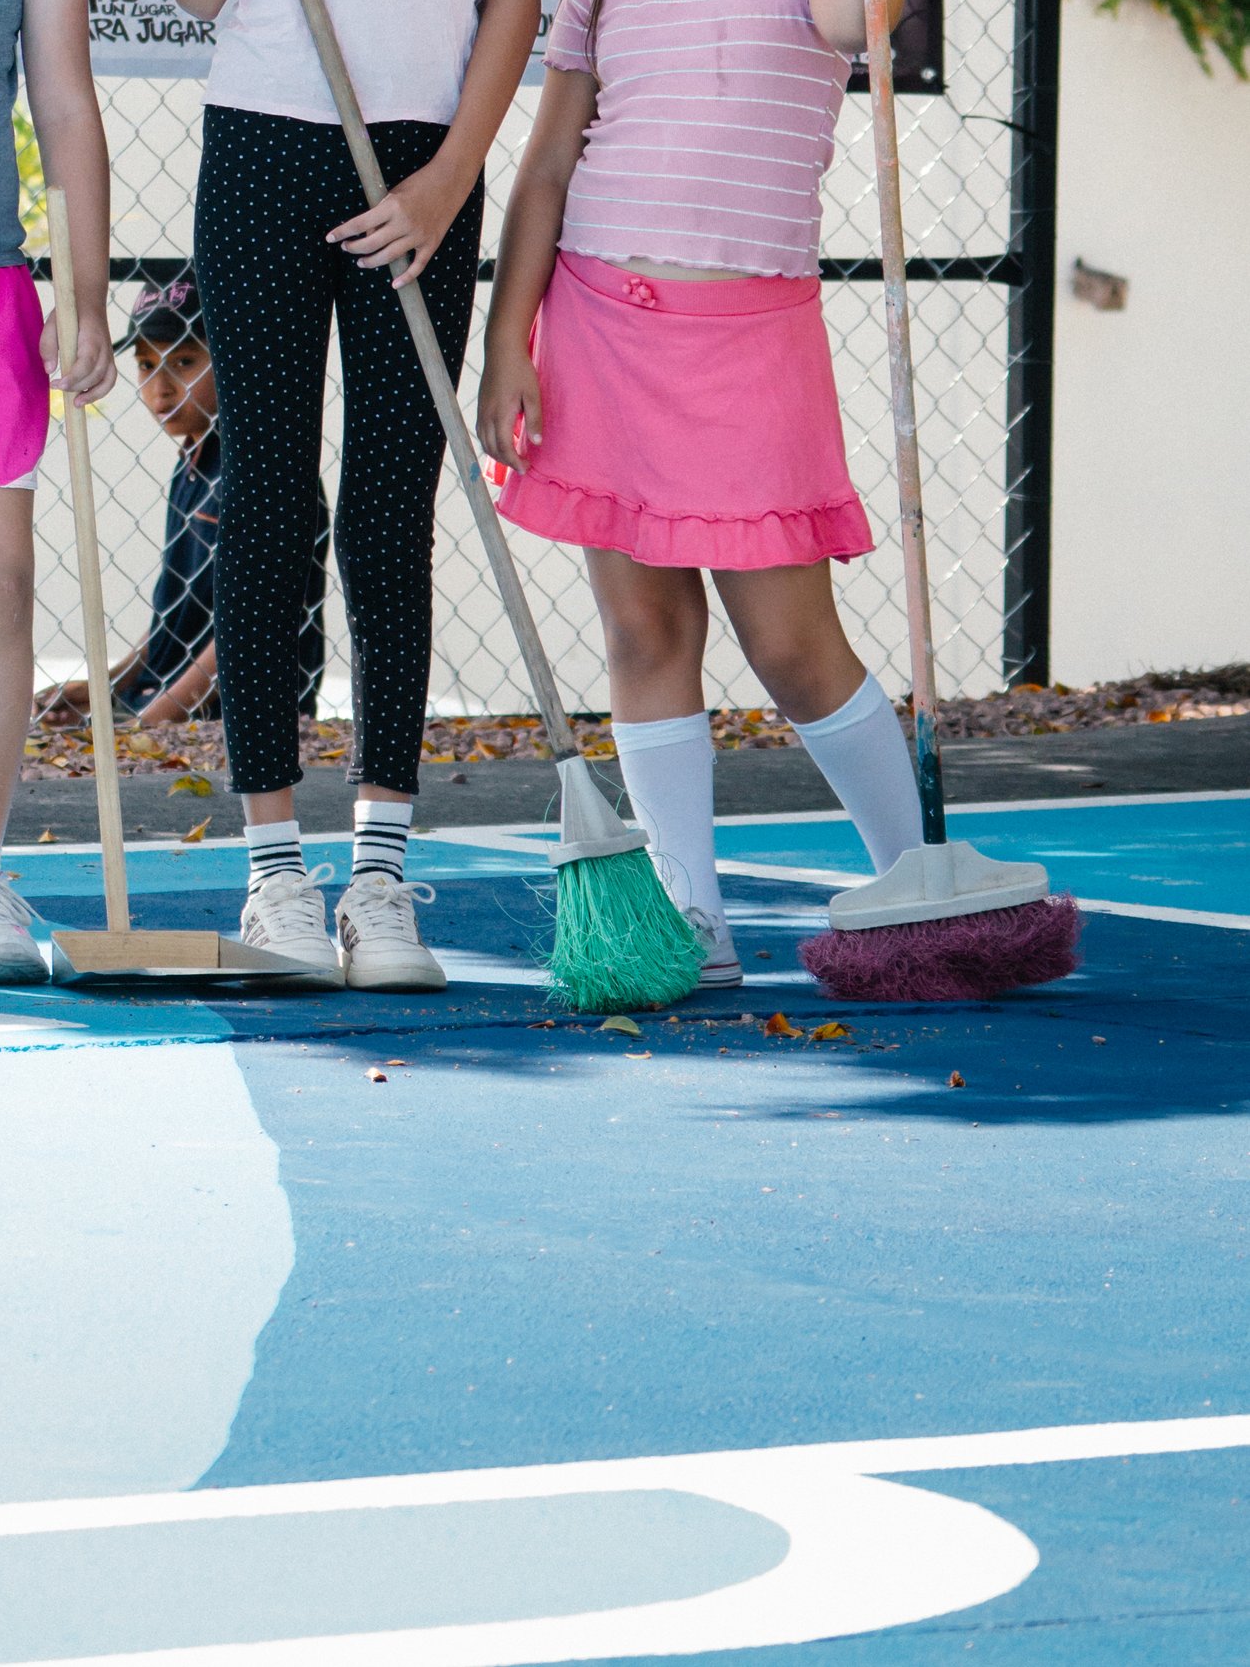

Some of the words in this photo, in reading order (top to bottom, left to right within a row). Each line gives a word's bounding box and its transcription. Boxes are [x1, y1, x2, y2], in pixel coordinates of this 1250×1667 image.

[102, 3, 125, 15] UN
[131, 3, 178, 17] LUGAR
[89, 18, 130, 43] RA
[136, 18, 217, 47] JUGAR
